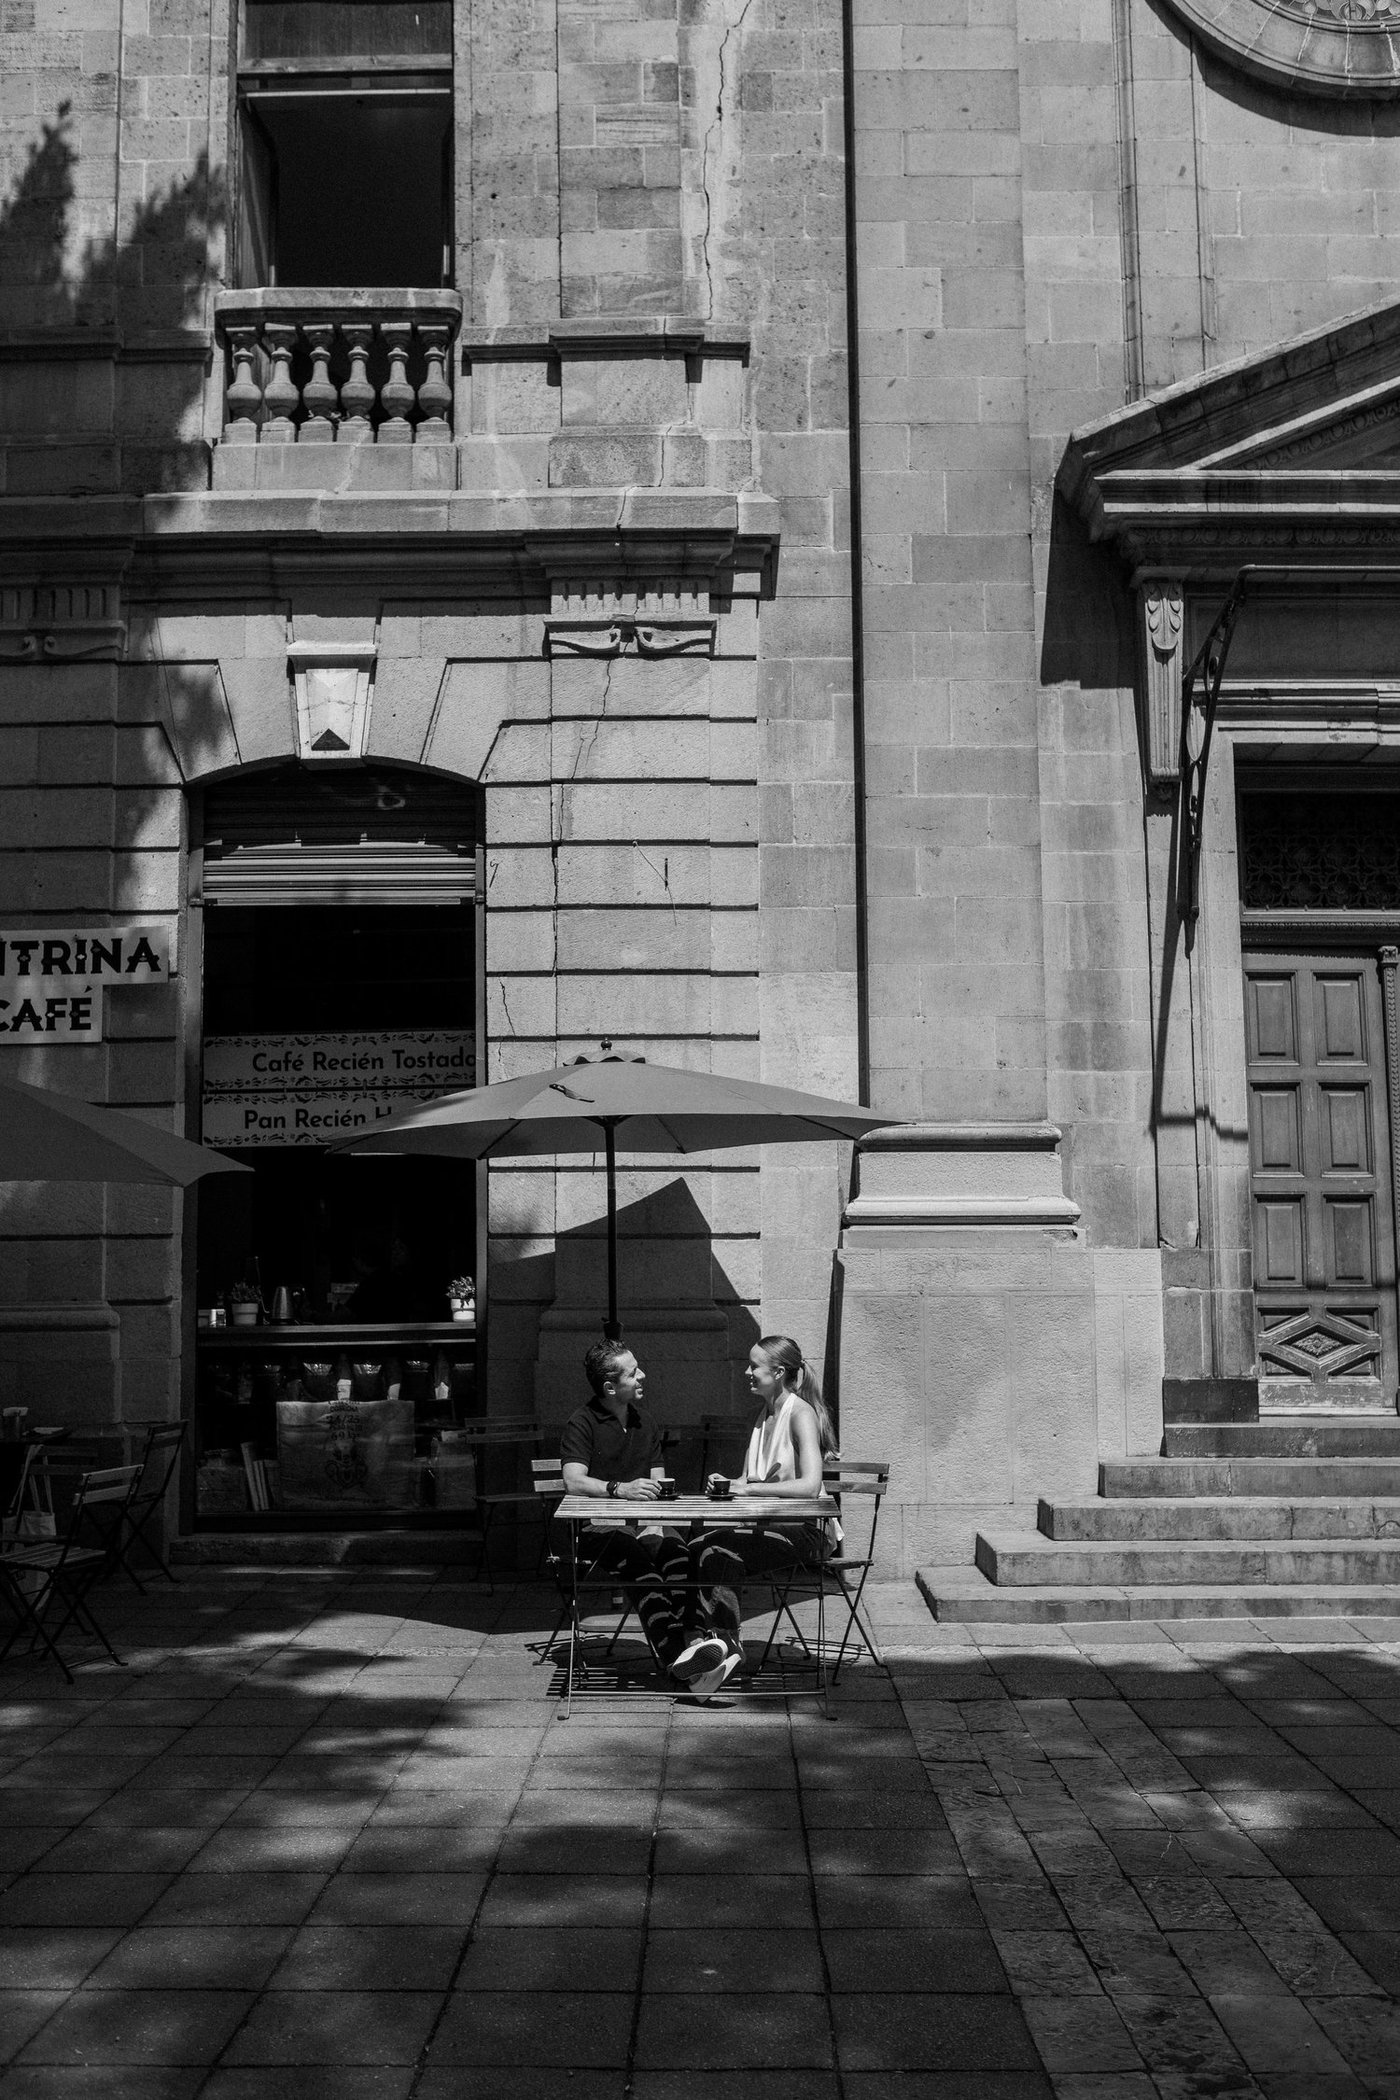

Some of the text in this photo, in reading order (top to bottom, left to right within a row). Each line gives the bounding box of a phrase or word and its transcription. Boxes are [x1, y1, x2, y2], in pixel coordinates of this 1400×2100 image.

[0, 937, 161, 976] TRINA
[252, 1046, 476, 1072] Café Recién Tostado
[244, 1109, 286, 1129] Pan
[295, 1108, 366, 1128] Recién
